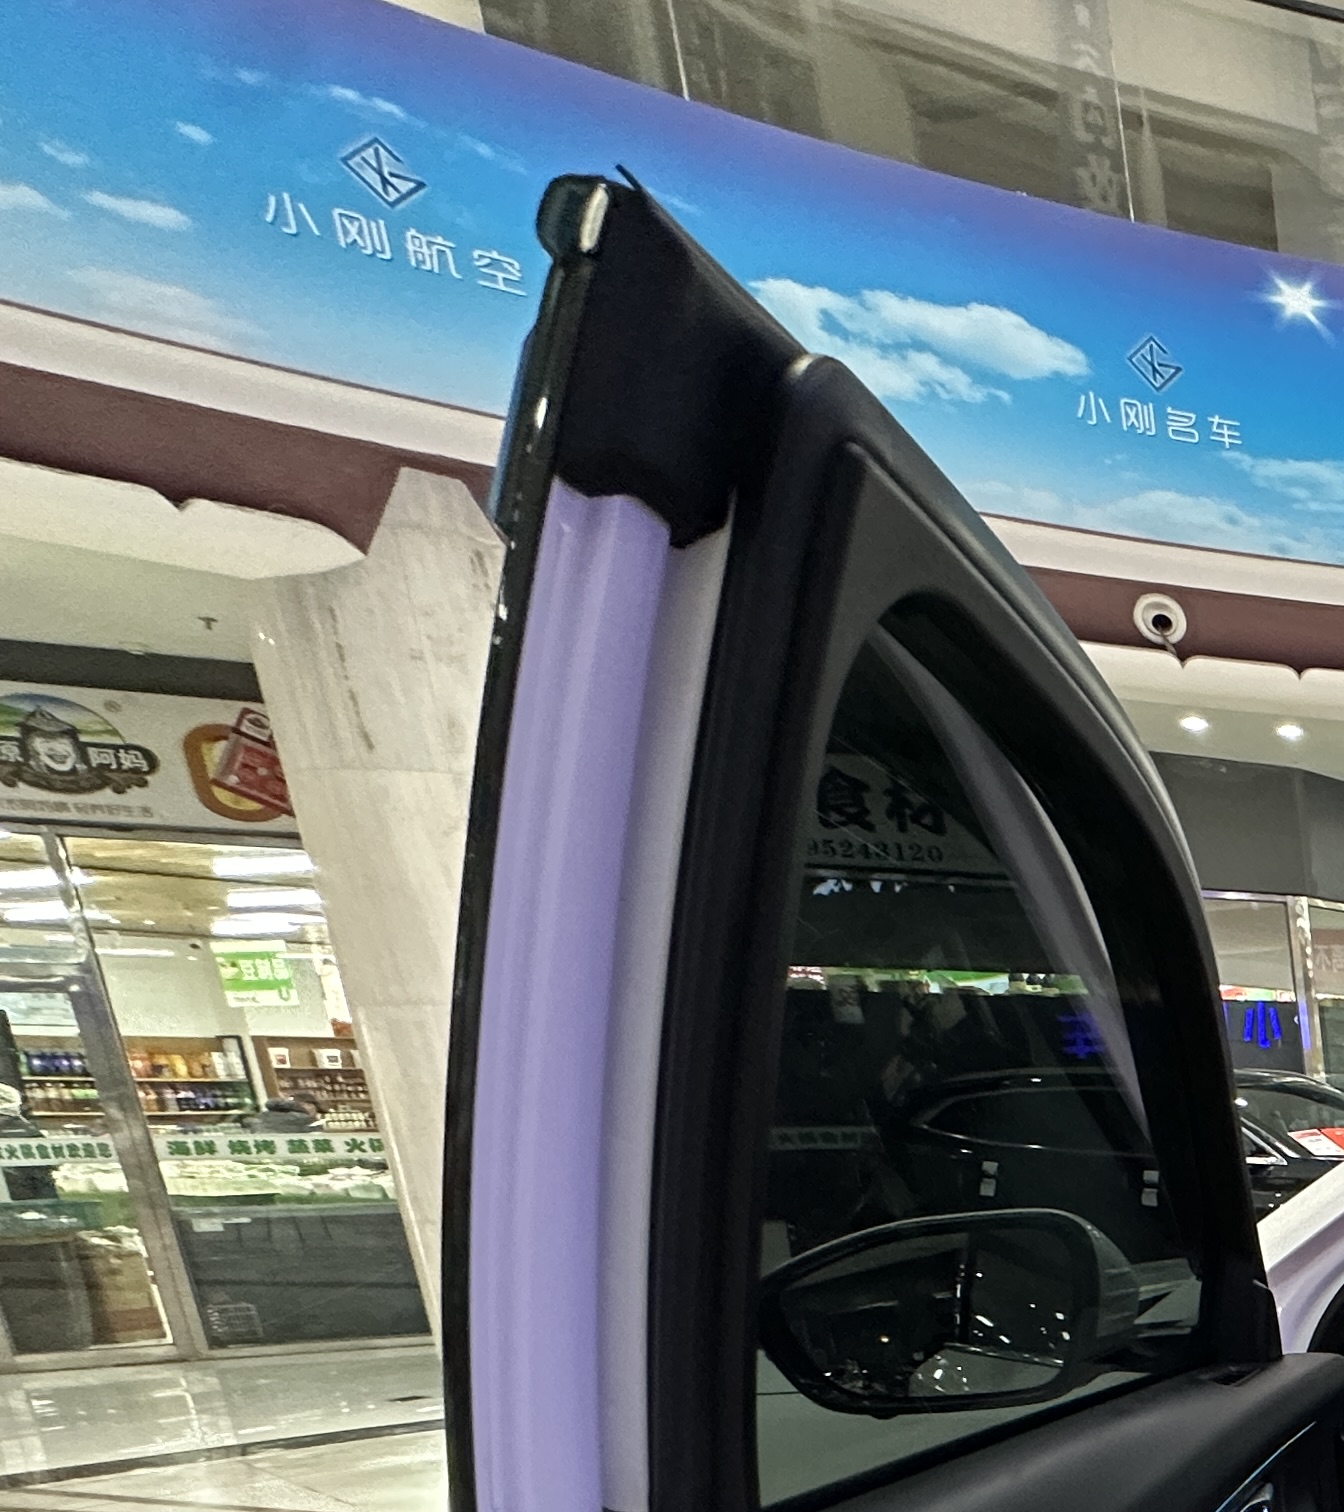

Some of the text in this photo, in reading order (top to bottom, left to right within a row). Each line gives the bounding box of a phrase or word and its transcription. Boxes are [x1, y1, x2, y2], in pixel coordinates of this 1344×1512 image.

[264, 191, 529, 297] 小刚航空
[1076, 390, 1244, 450] 小刚名车
[86, 746, 150, 772] 阿妈
